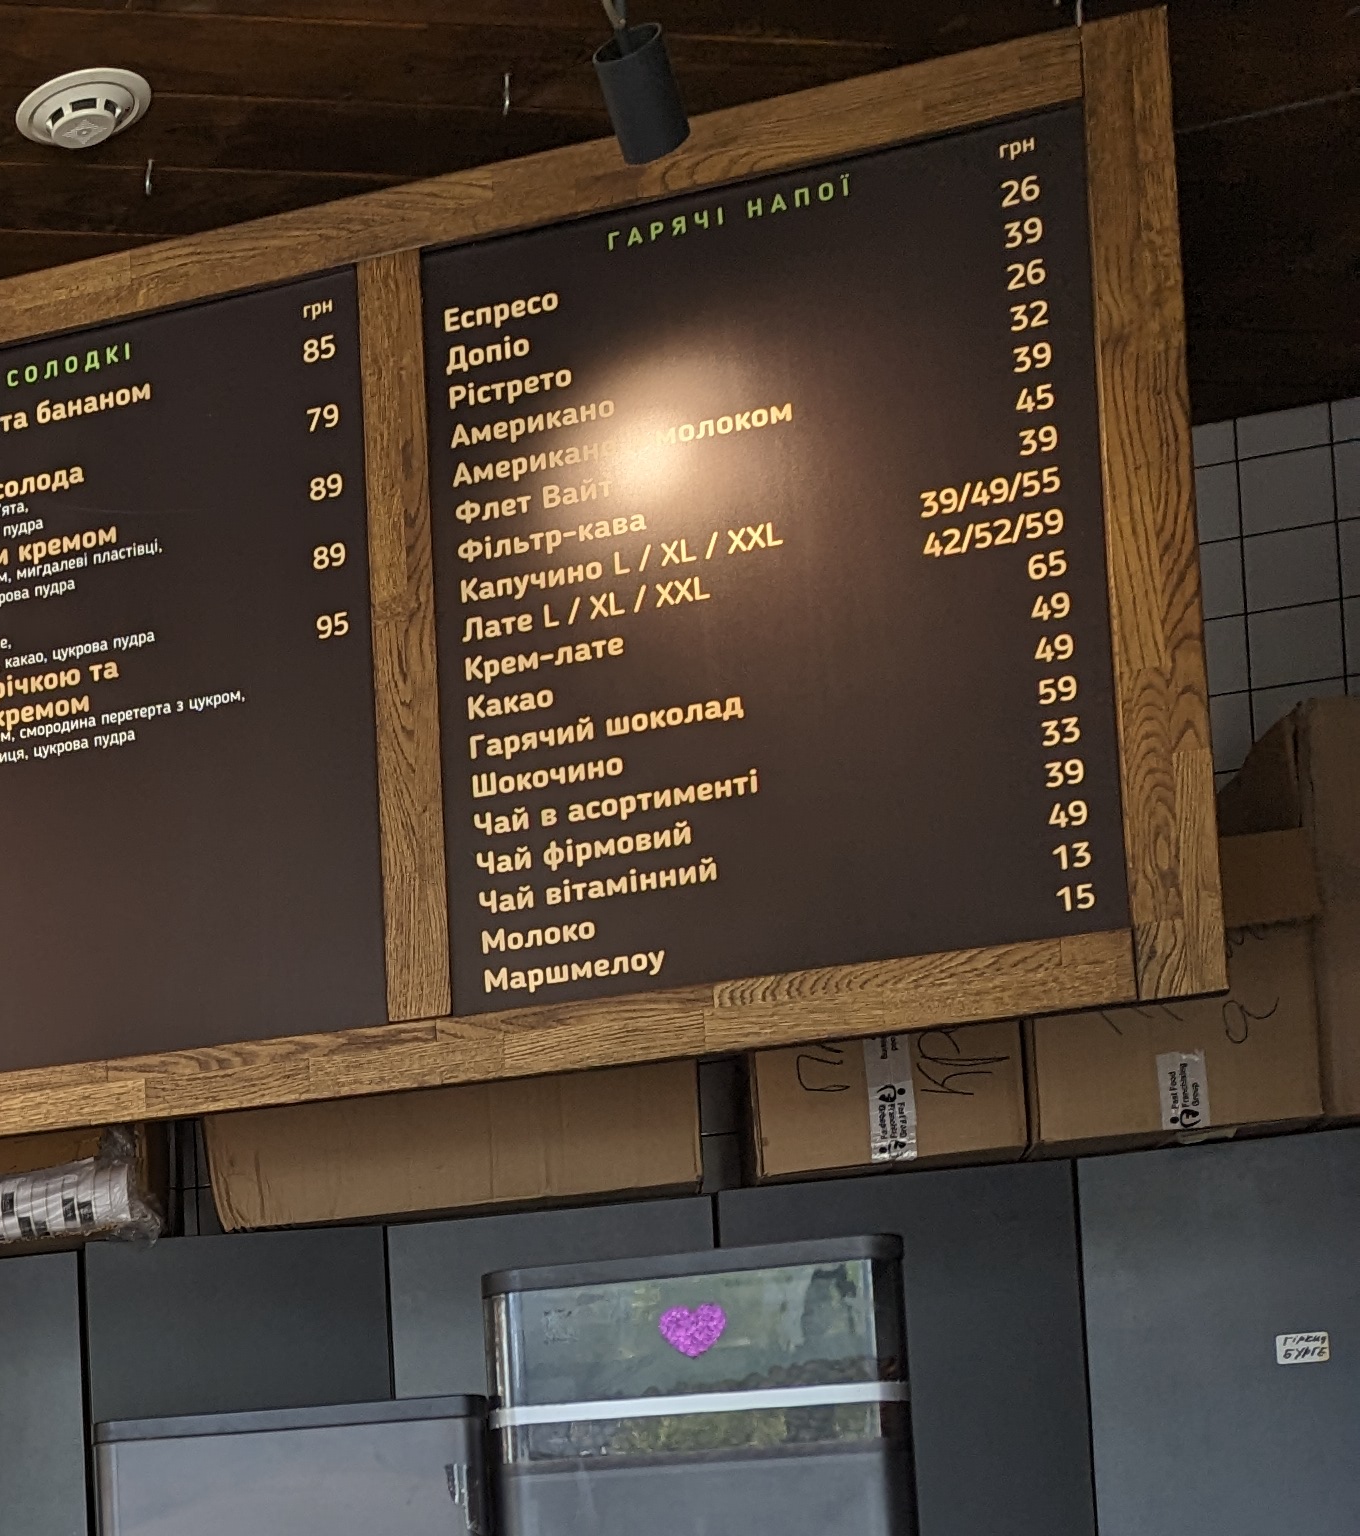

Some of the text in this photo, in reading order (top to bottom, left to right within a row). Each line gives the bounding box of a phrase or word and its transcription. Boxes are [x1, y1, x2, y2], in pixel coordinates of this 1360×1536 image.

[606, 173, 854, 252] ГАРЯЧІ НАПОЇ
[1000, 175, 1040, 208] 26
[444, 290, 558, 334] Еспресо
[6, 341, 133, 389] СОЛОДКІ
[302, 334, 336, 364] 85
[446, 335, 530, 376] Допіо
[0, 409, 27, 433] та
[36, 381, 152, 423] бананом
[450, 397, 615, 449] Американо
[919, 467, 1061, 518] 39/49/55
[922, 508, 1065, 560] 42/52/59
[468, 693, 745, 761] Гарячий шоколад
[478, 856, 718, 916] Чай вітамінний
[483, 948, 666, 994] Маршмелоу
